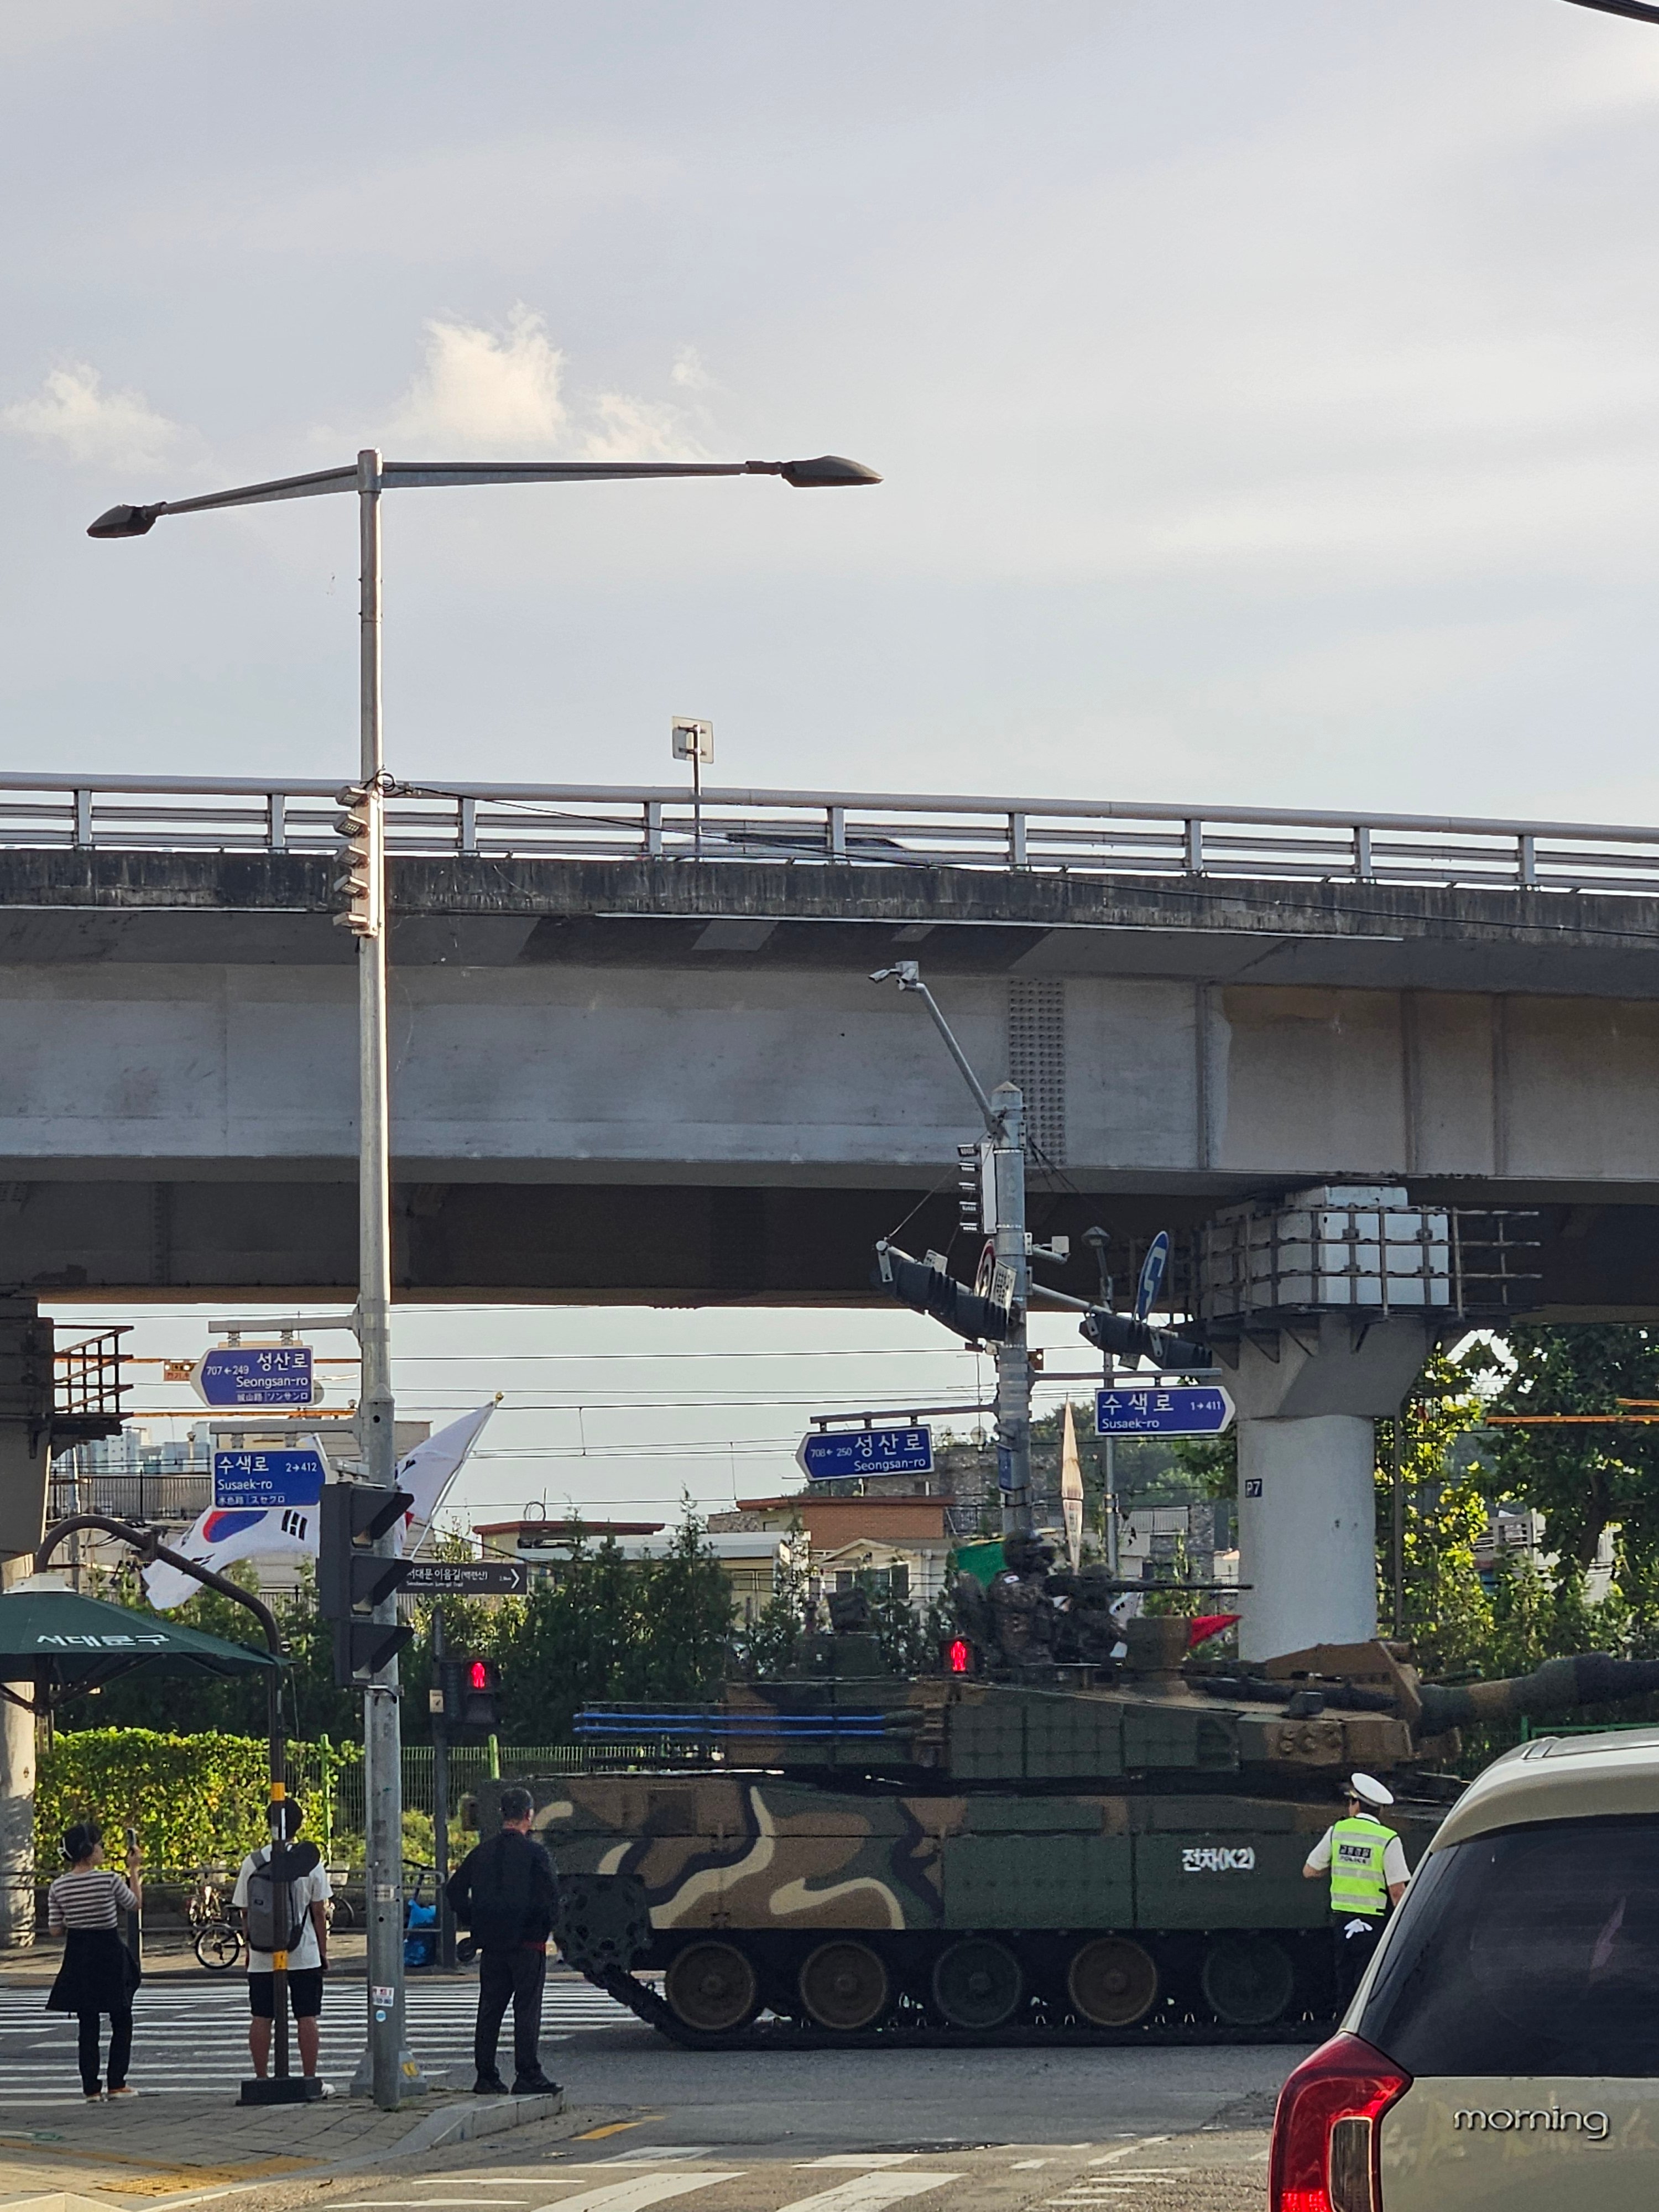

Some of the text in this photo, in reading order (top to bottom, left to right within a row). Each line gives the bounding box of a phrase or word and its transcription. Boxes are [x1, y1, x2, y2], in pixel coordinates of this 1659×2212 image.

[257, 1353, 308, 1371] 성산로
[206, 1366, 222, 1375] 707
[233, 1365, 249, 1375] 249
[236, 1376, 307, 1389] Seongsan-ro
[1102, 1393, 1174, 1416] 수색로
[1102, 1418, 1160, 1429] Susaek-ro
[836, 1447, 852, 1457] 250
[854, 1433, 924, 1457] 성산로
[217, 1455, 269, 1475] 수색로
[301, 1463, 317, 1472] 412
[854, 1458, 926, 1472] Seongsan-ro
[217, 1479, 273, 1490] Susaek-ro
[1246, 1481, 1260, 1495] P7
[36, 1632, 170, 1647] 서대문구
[1182, 1846, 1255, 1871] 전차(K2)
[1453, 2105, 1610, 2140] morning
